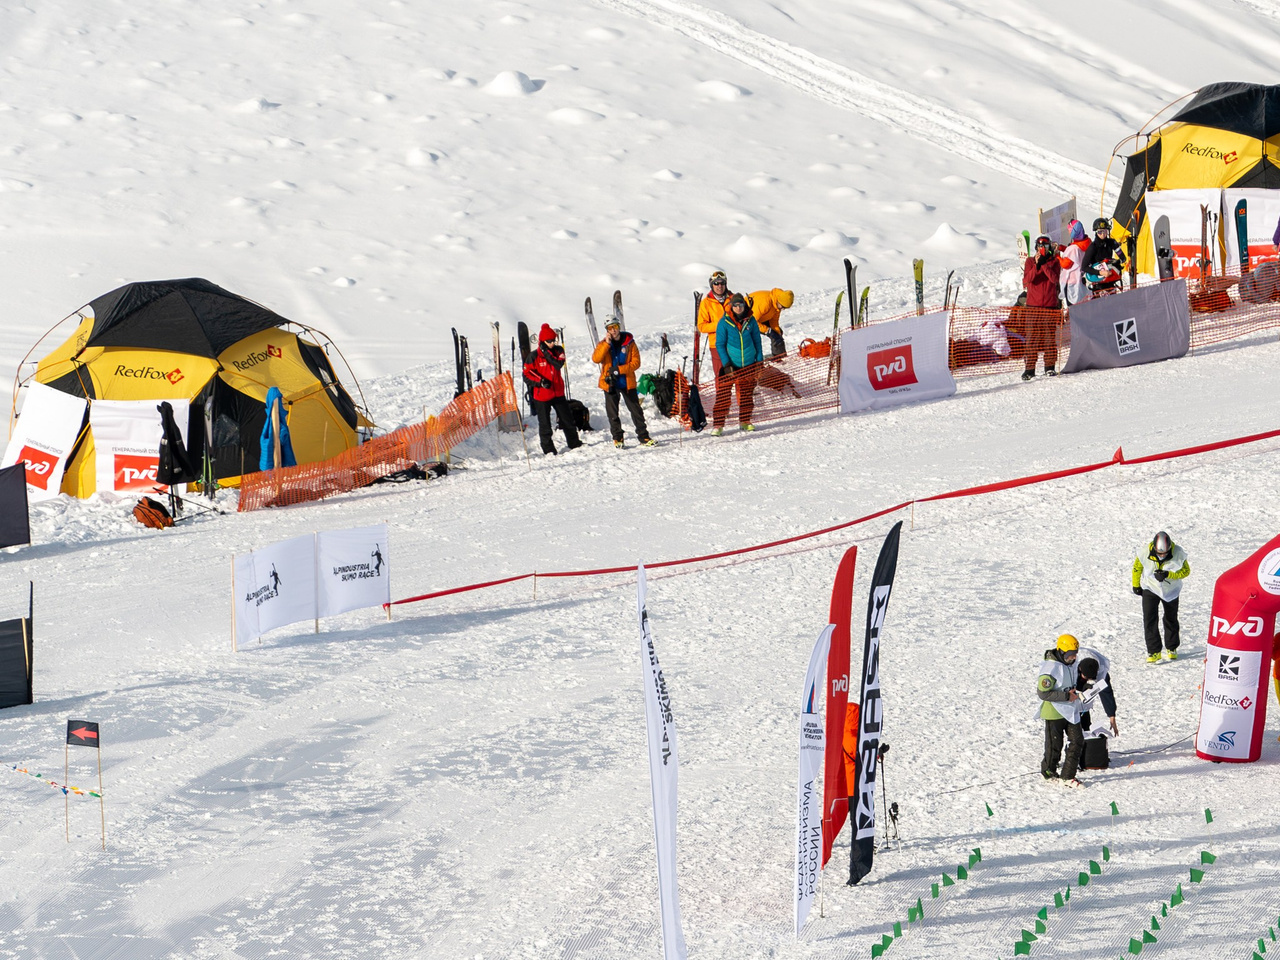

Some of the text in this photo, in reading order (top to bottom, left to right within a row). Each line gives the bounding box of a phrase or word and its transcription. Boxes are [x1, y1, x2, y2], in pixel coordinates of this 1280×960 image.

[1182, 143, 1224, 160] RedFox
[1120, 344, 1139, 354] BASK
[232, 350, 270, 372] RedFox
[114, 365, 168, 381] RedFox
[333, 563, 370, 575] ALPINDUSTRIA
[341, 570, 375, 582] SKIMO RACE
[1205, 690, 1240, 707] RedFox
[1203, 739, 1230, 751] VENTO
[809, 826, 822, 895] РОССИИ
